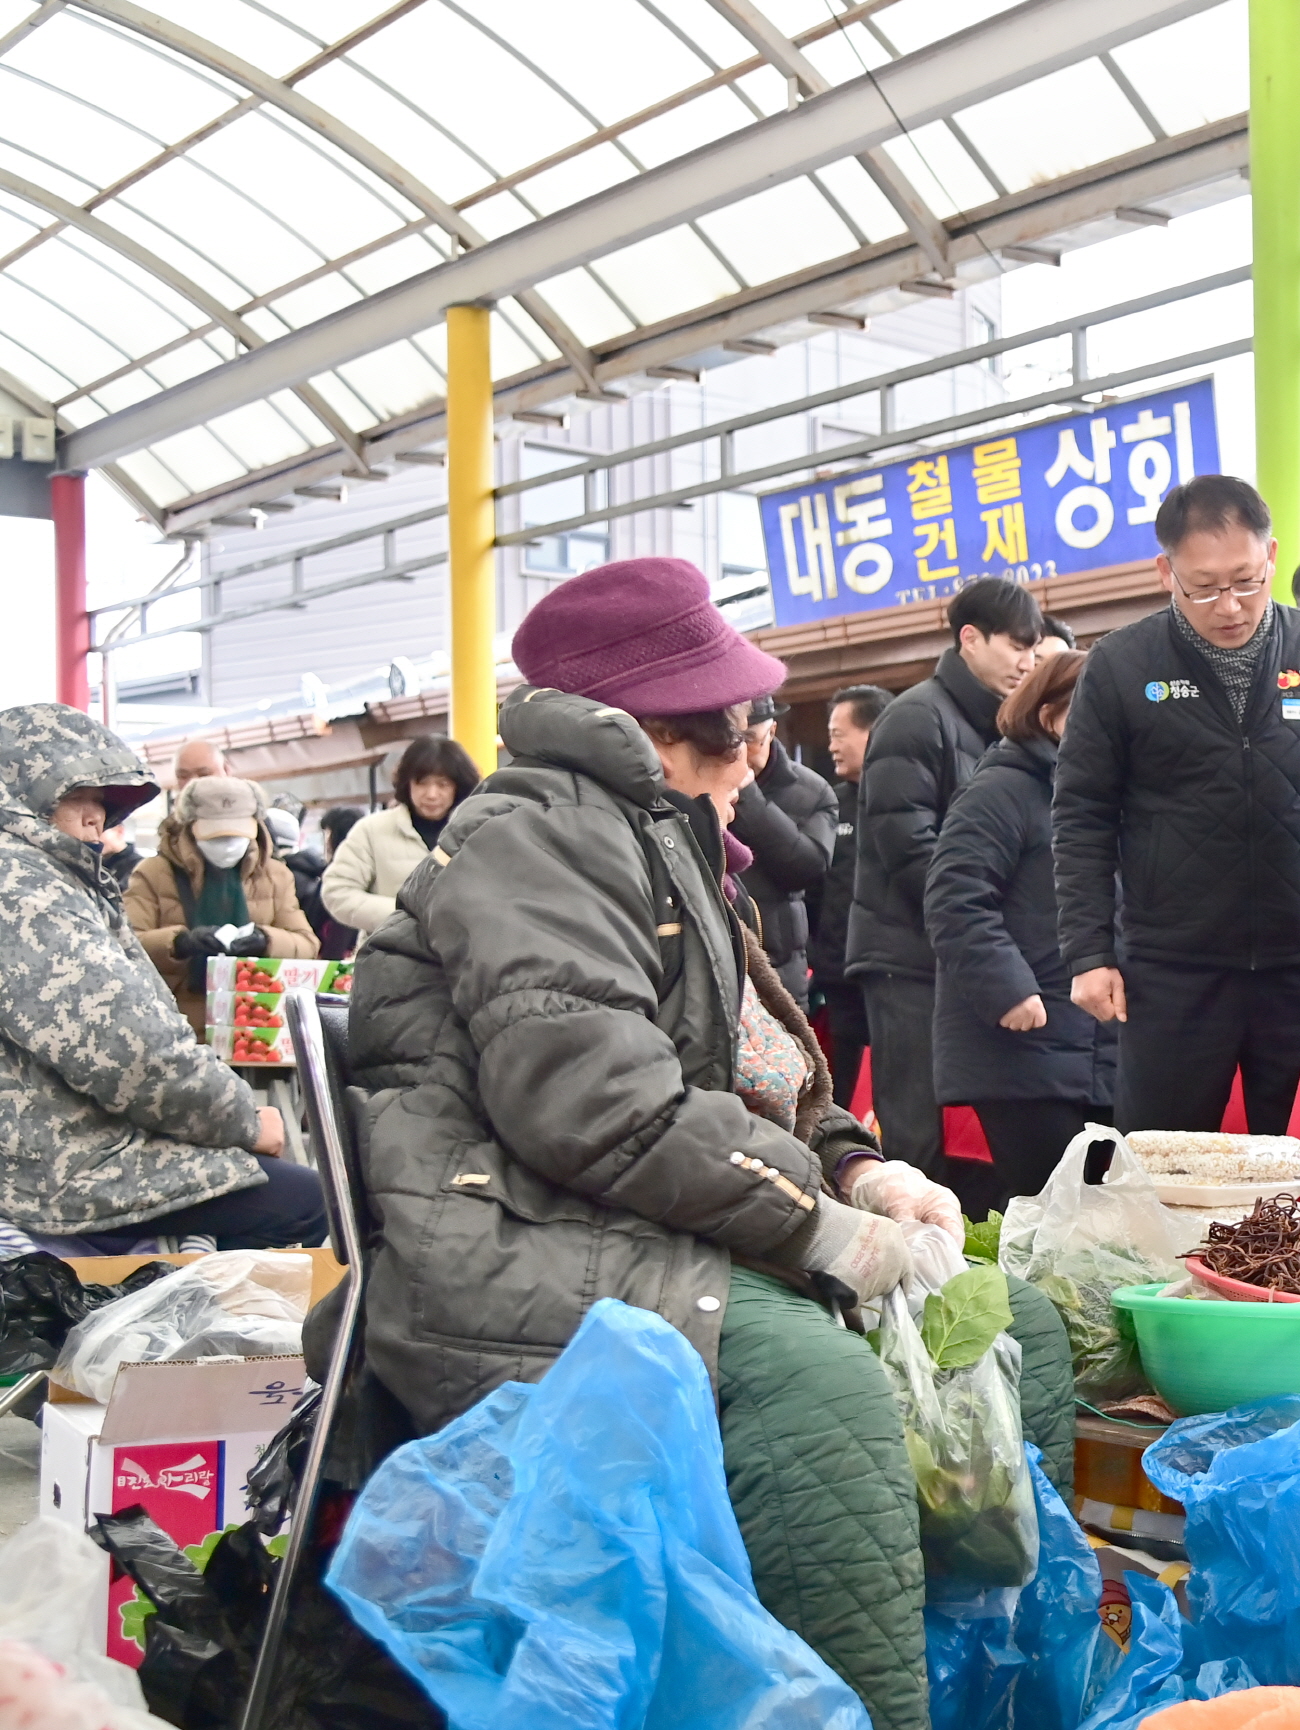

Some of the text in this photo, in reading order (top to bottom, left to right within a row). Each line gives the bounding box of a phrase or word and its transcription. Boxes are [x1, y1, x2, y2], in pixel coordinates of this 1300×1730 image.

[906, 437, 1022, 520] 철물
[1045, 401, 1195, 549] 상회
[779, 474, 895, 602] 대동
[913, 502, 1029, 581] 건재
[1170, 685, 1200, 700] 청송군
[283, 967, 319, 987] 딸기
